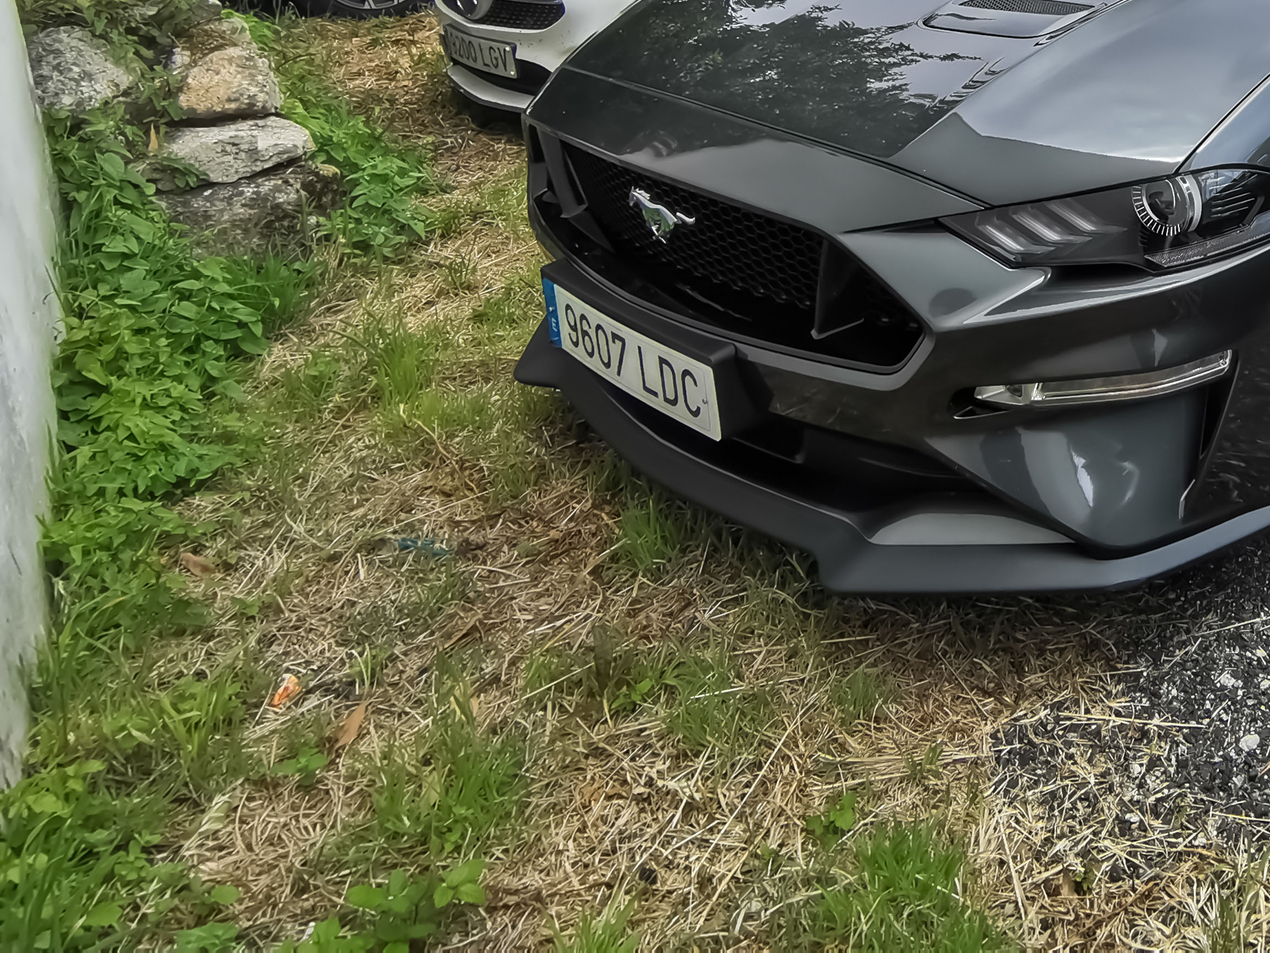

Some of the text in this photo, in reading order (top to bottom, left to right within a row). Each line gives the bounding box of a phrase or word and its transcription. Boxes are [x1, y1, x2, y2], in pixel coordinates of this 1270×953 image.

[478, 43, 507, 72] LGV
[564, 303, 626, 377] 9607
[637, 345, 701, 418] LDC
